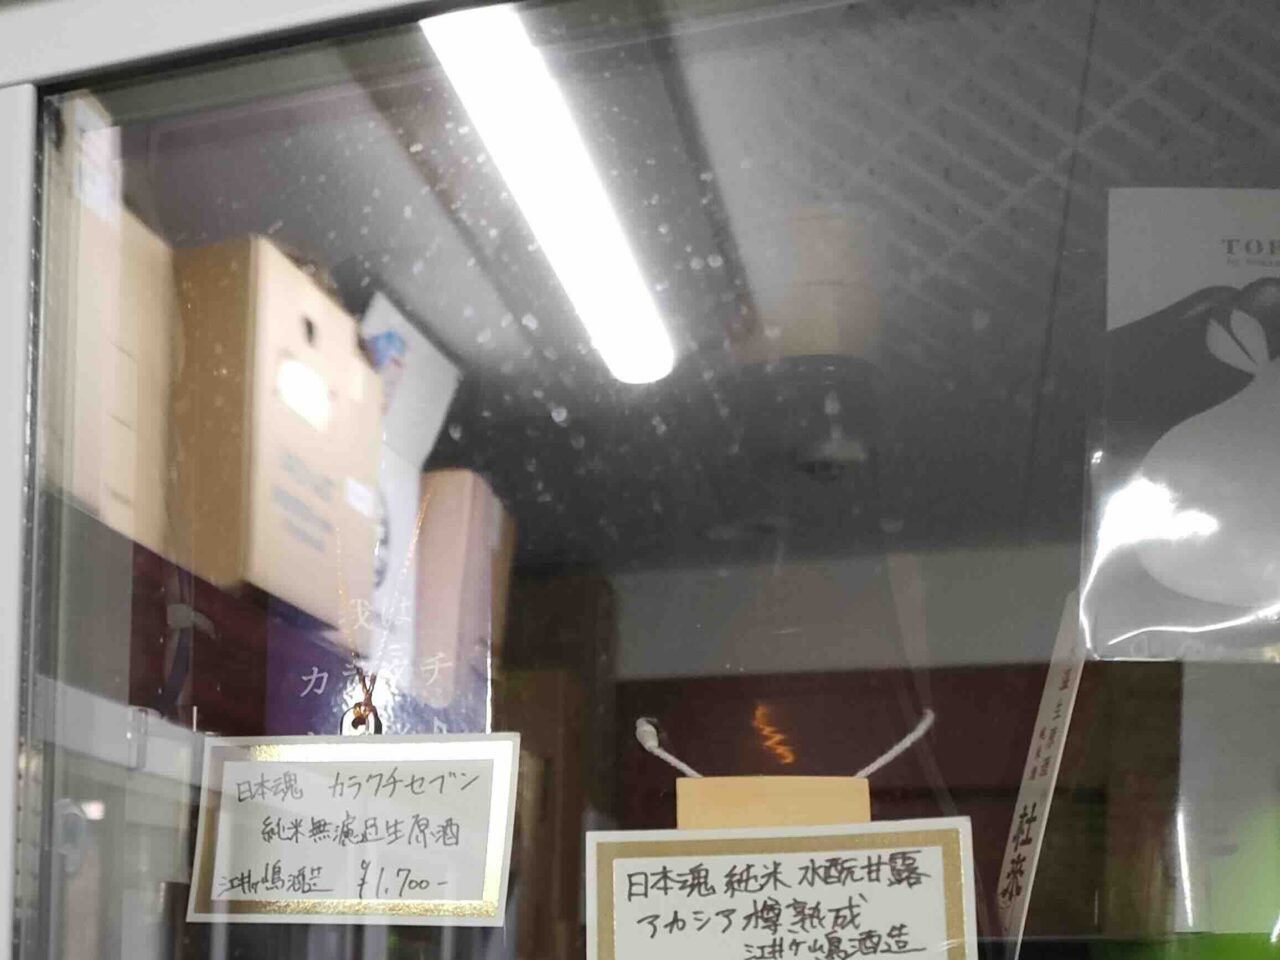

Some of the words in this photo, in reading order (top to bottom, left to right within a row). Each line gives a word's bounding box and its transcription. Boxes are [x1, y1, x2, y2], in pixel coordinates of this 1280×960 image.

[236, 772, 304, 802] 日本魂
[328, 767, 480, 798] カラクチセブン
[627, 863, 716, 902] 日本魂
[724, 861, 792, 898] 純米
[637, 893, 868, 938] アカシア樽熟成
